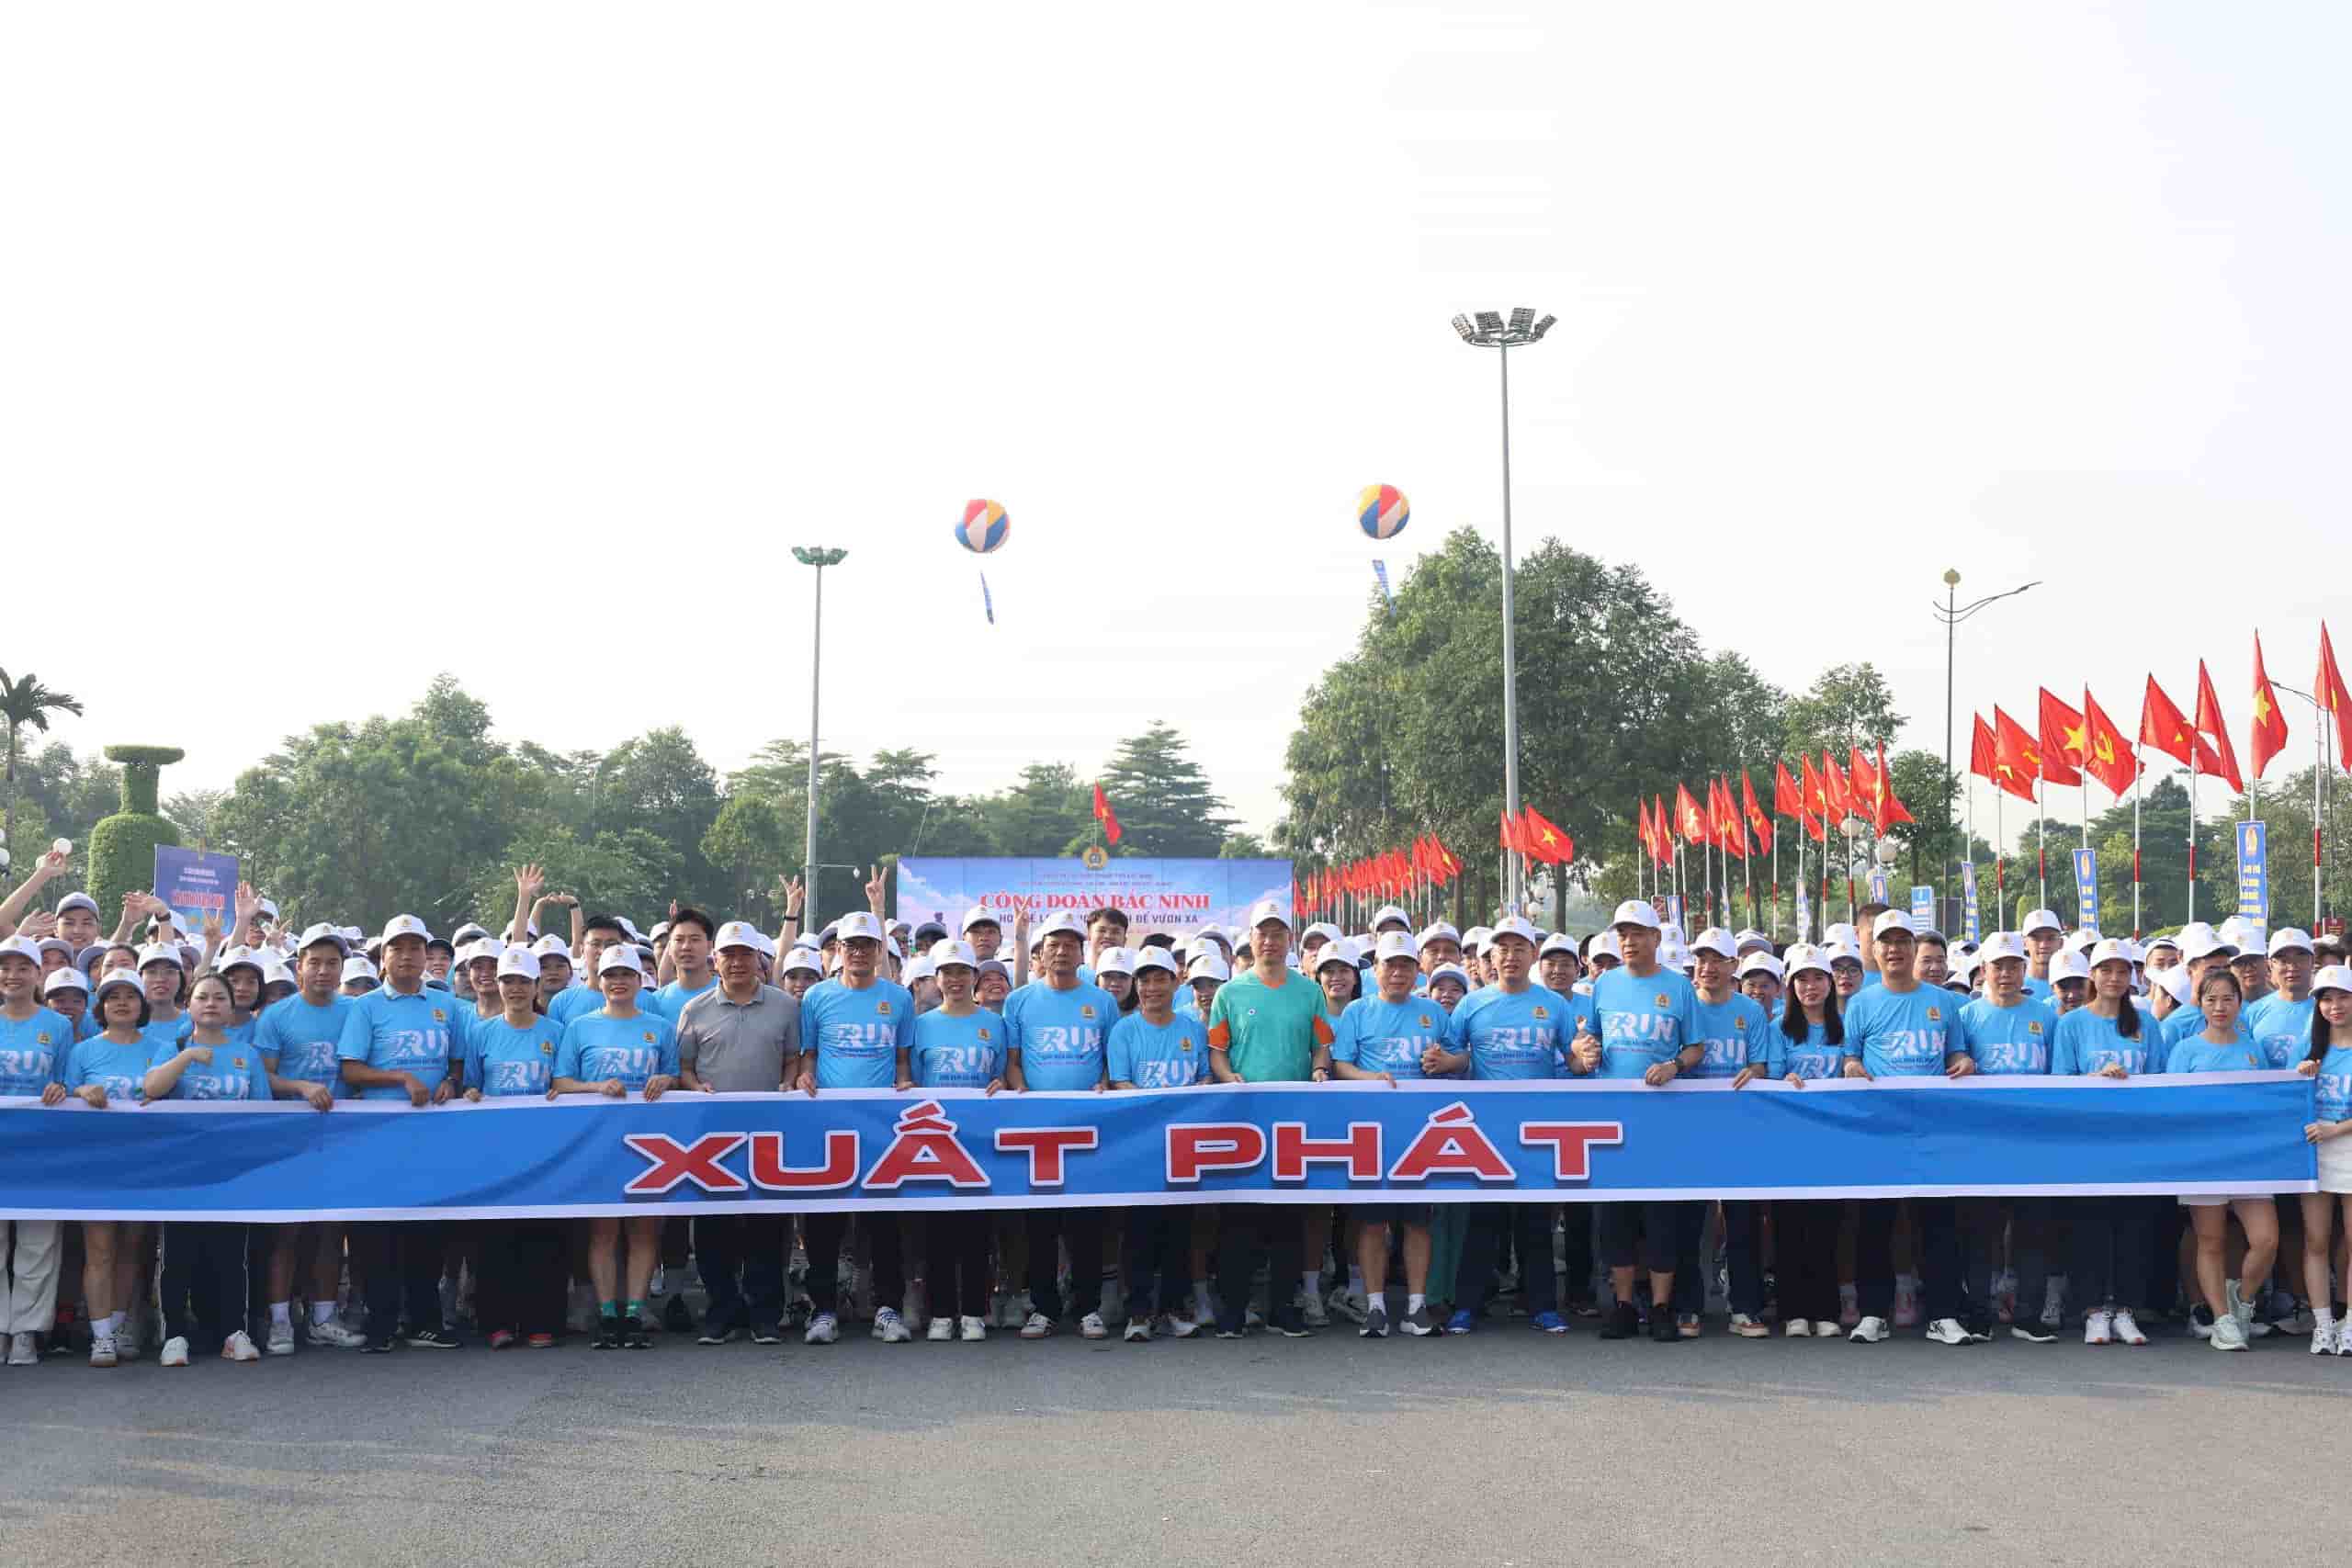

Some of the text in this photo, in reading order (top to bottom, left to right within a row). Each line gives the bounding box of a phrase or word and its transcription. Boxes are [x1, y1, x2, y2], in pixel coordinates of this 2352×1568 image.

[1159, 895, 1210, 909] NINH
[624, 1100, 1623, 1193] XUẤT PHÁT
